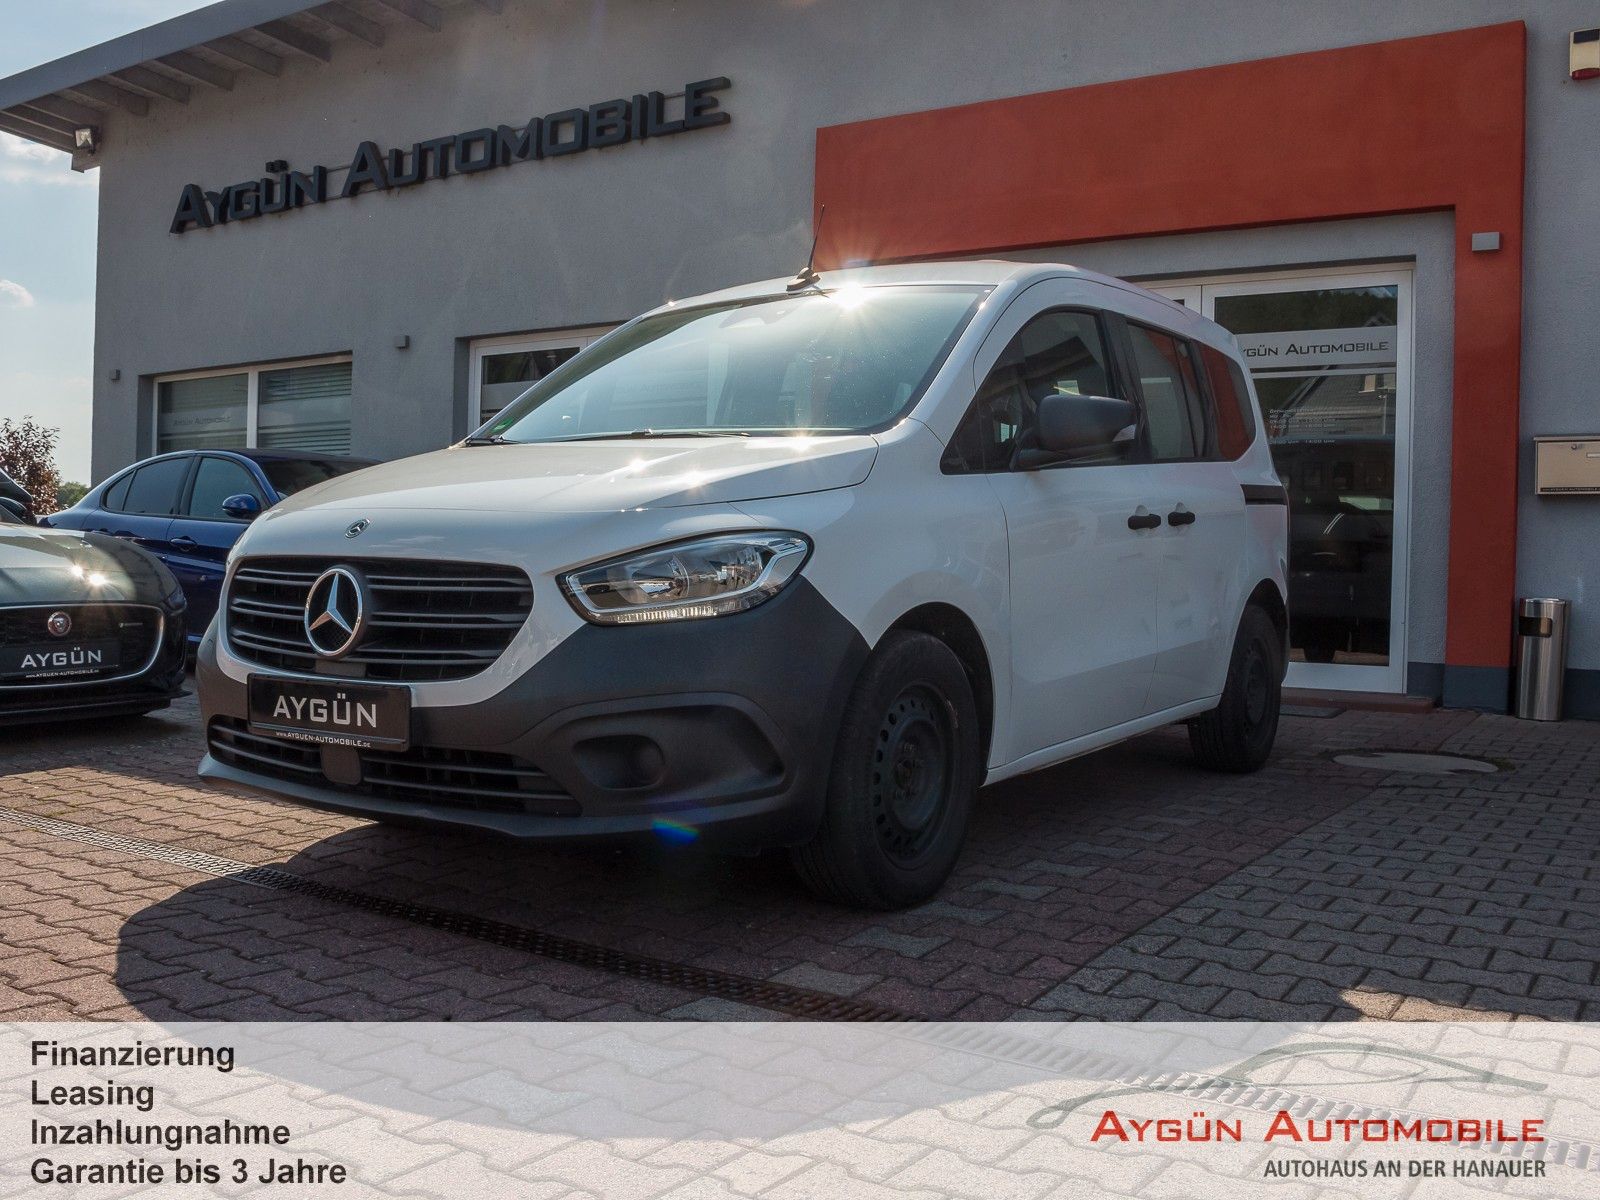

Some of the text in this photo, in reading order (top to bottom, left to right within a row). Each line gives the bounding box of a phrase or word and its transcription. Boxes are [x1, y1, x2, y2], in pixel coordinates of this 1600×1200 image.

[170, 76, 731, 234] AYGÜN AUTOMOBILE
[1243, 341, 1389, 357] GÜN AUTOMOBILE
[21, 646, 102, 669] AYGÜN
[272, 692, 377, 728] AYGÜN
